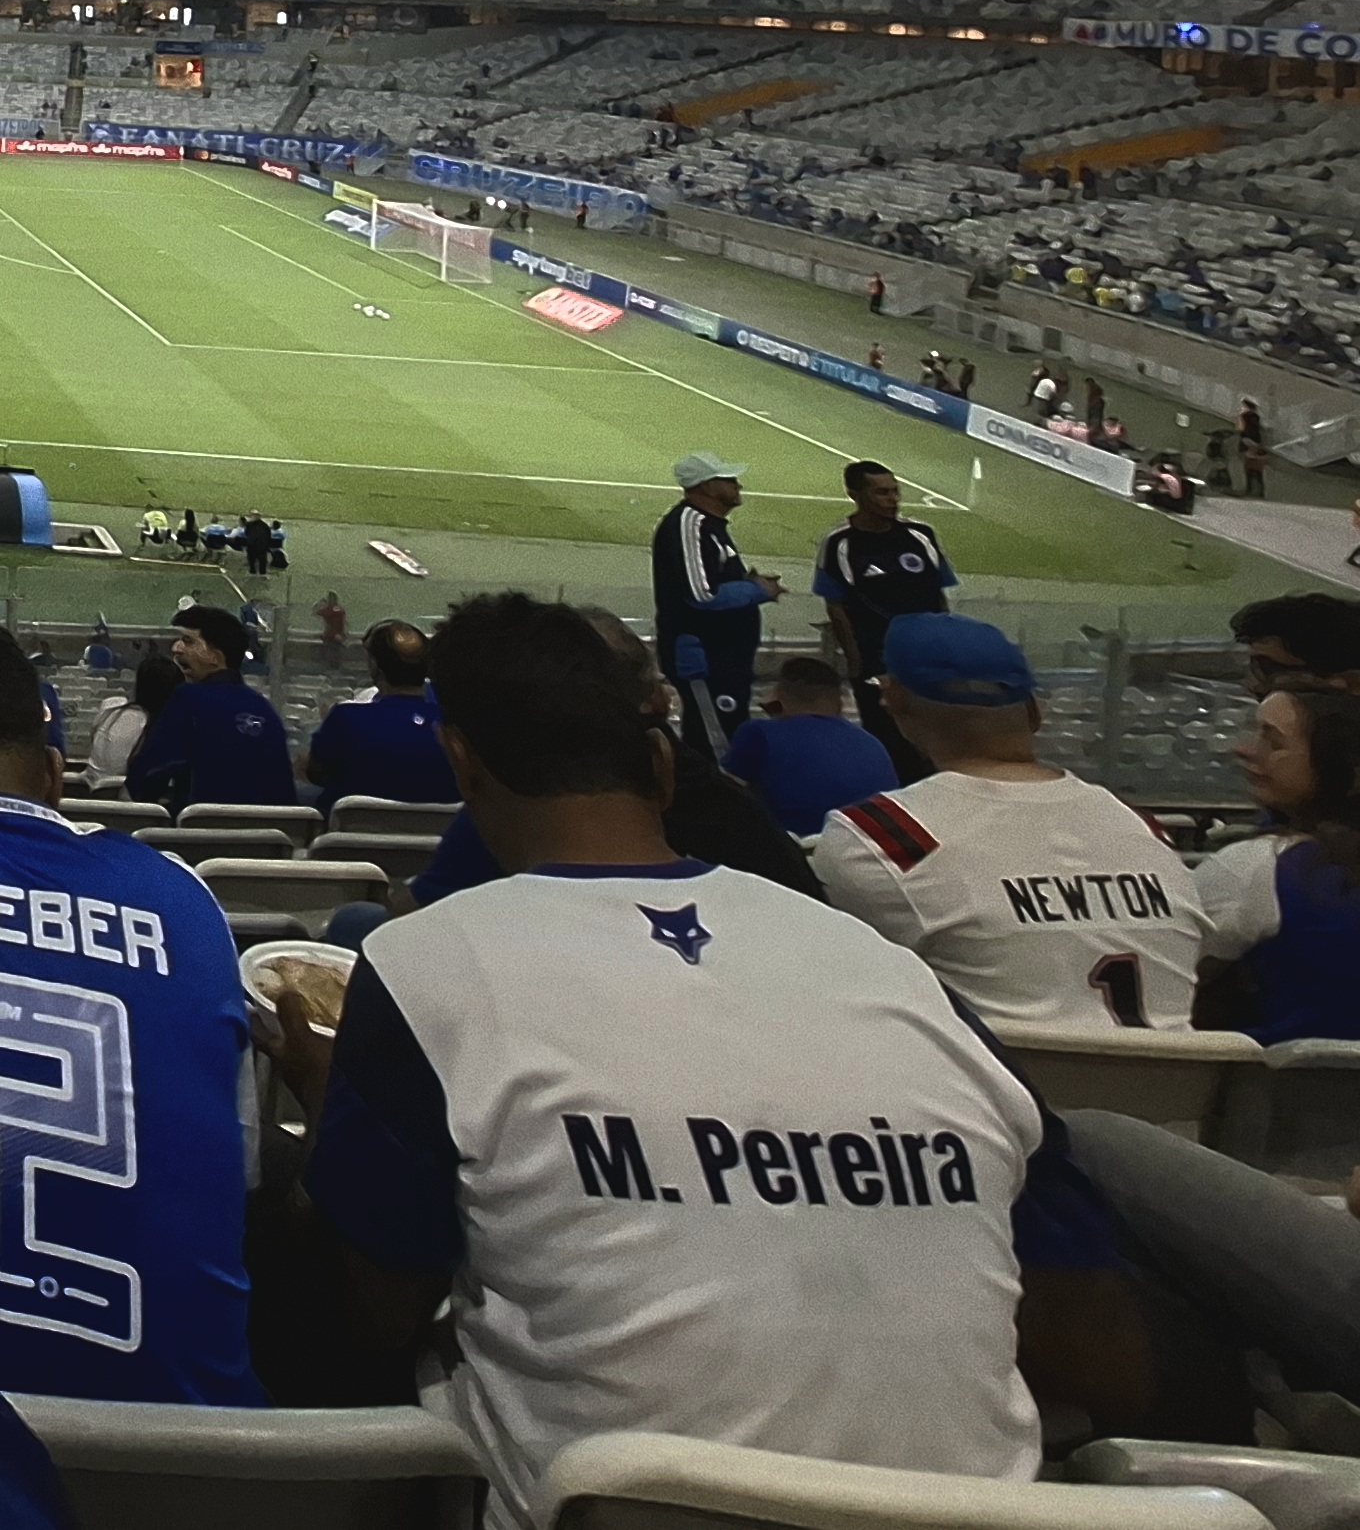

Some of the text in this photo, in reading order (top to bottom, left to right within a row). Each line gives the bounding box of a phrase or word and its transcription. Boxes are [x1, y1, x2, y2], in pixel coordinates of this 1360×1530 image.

[1116, 21, 1211, 50] MURO
[1227, 28, 1279, 55] DE
[35, 141, 90, 155] mapfre
[111, 145, 167, 158] mapfre
[512, 249, 591, 290] sportingbet
[986, 419, 1074, 464] CONMEBOL
[1000, 873, 1173, 924] NEWTON
[1088, 952, 1152, 1028] 1
[562, 1113, 979, 1206] M. Pereira
